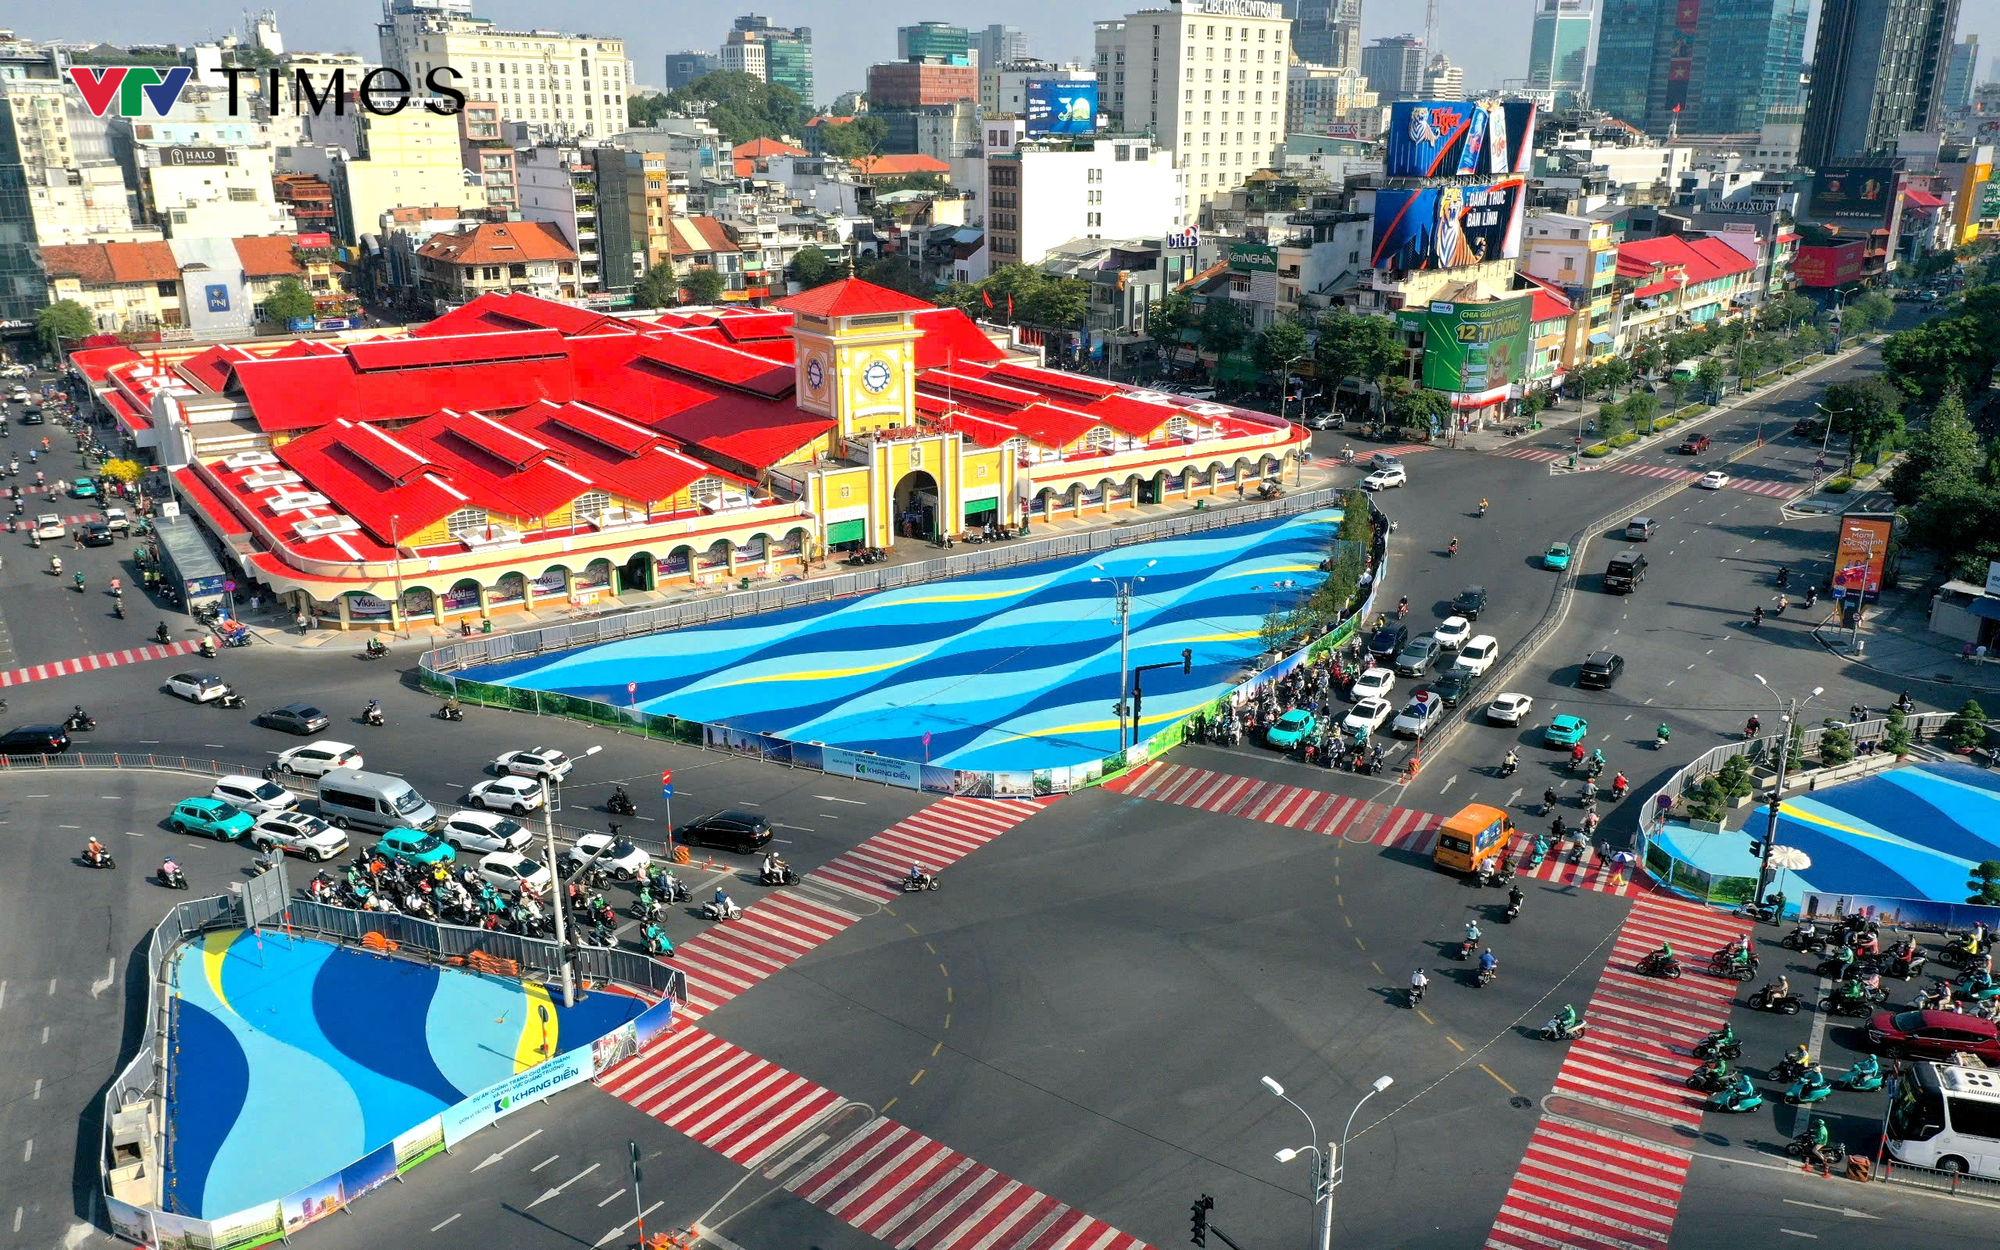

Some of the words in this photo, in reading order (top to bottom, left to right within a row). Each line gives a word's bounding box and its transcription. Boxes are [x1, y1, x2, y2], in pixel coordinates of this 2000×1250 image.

[1431, 106, 1463, 135] Tiger
[186, 151, 216, 160] HALO
[1711, 201, 1733, 210] KING
[1735, 202, 1776, 211] LUXURY
[211, 299, 226, 307] PNJ
[1457, 325, 1476, 340] 12
[533, 575, 553, 585] Vikki
[446, 588, 466, 600] Vikki
[354, 596, 376, 607] Vikki
[867, 767, 892, 777] KHANG
[509, 1074, 528, 1085] TRANG
[552, 1055, 571, 1066] THÀNH
[512, 1079, 552, 1103] KHANG
[552, 1066, 579, 1085] ĐIỀN
